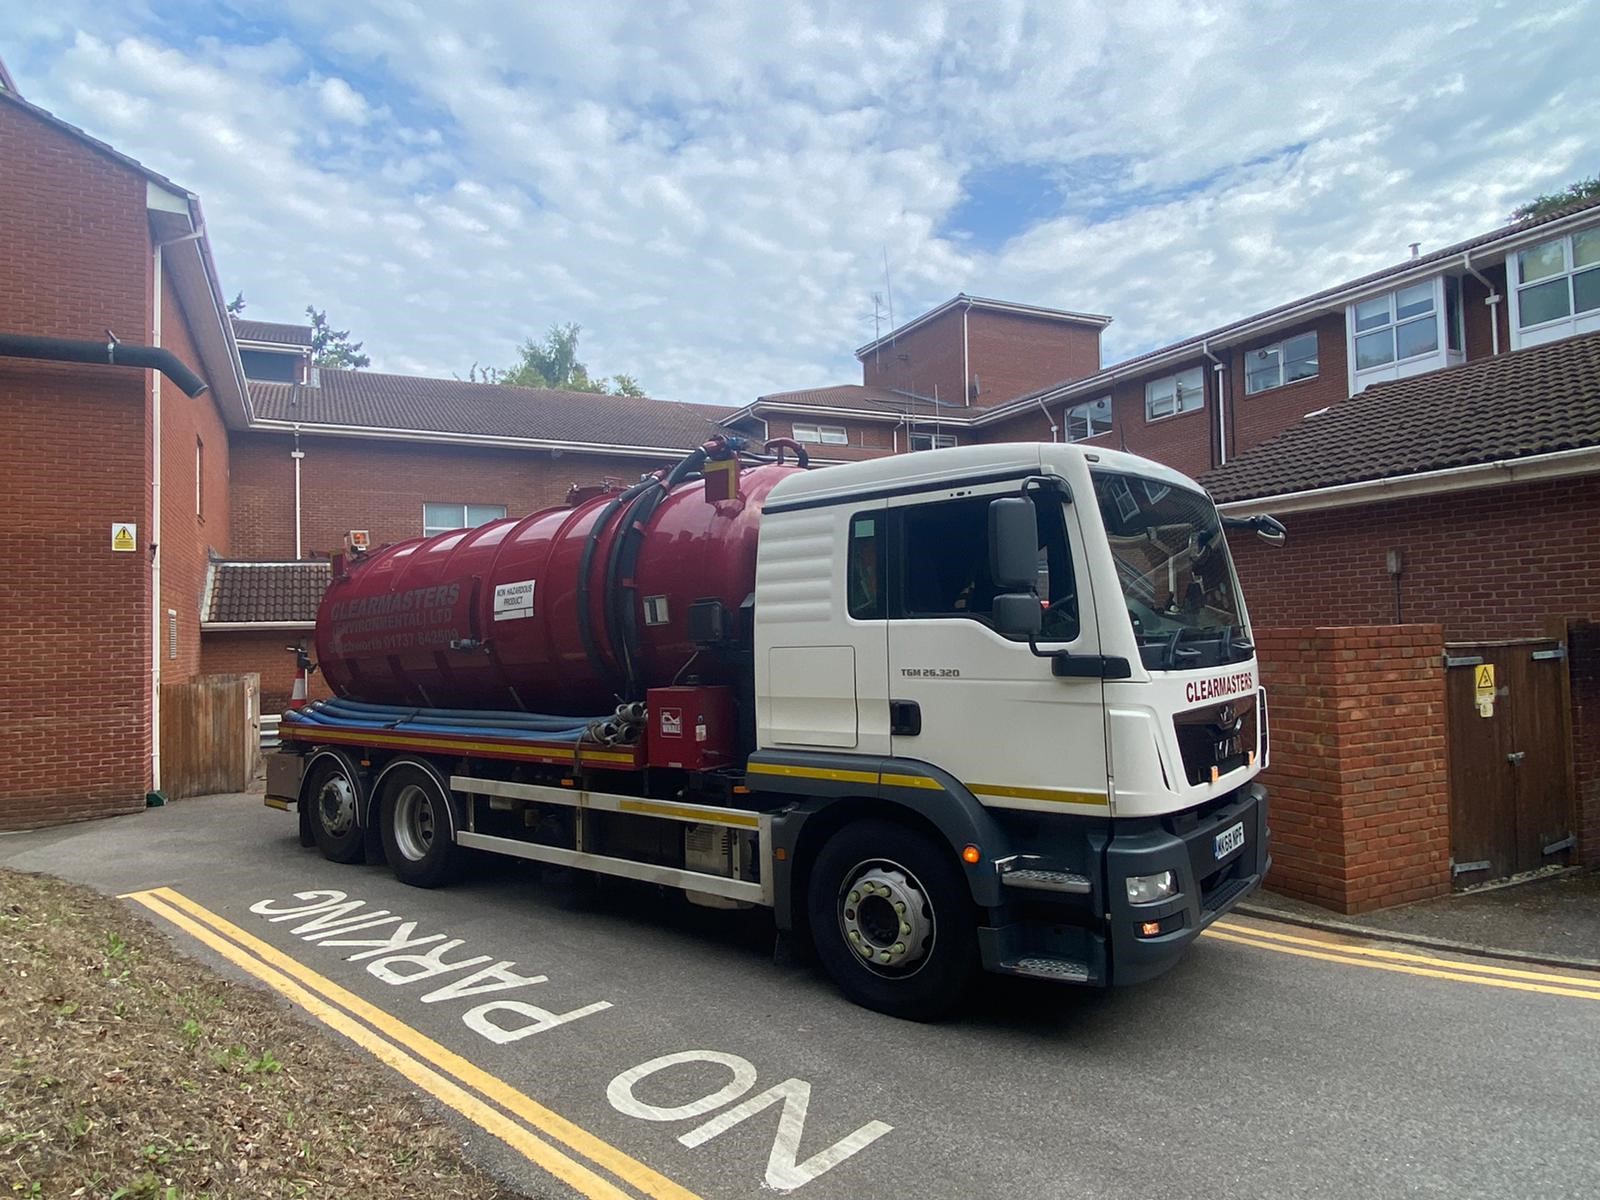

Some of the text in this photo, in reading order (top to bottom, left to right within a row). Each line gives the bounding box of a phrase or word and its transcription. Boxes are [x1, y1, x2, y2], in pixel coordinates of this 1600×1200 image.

[506, 584, 533, 596] HAZARDOUS
[330, 583, 460, 621] CLEARMASTERS
[504, 596, 523, 606] PRODUCT
[430, 608, 453, 625] LTD
[901, 669, 960, 677] TGM 26.320
[1186, 672, 1253, 703] CLEARMASTERS
[249, 889, 895, 1194] NO PARKING
